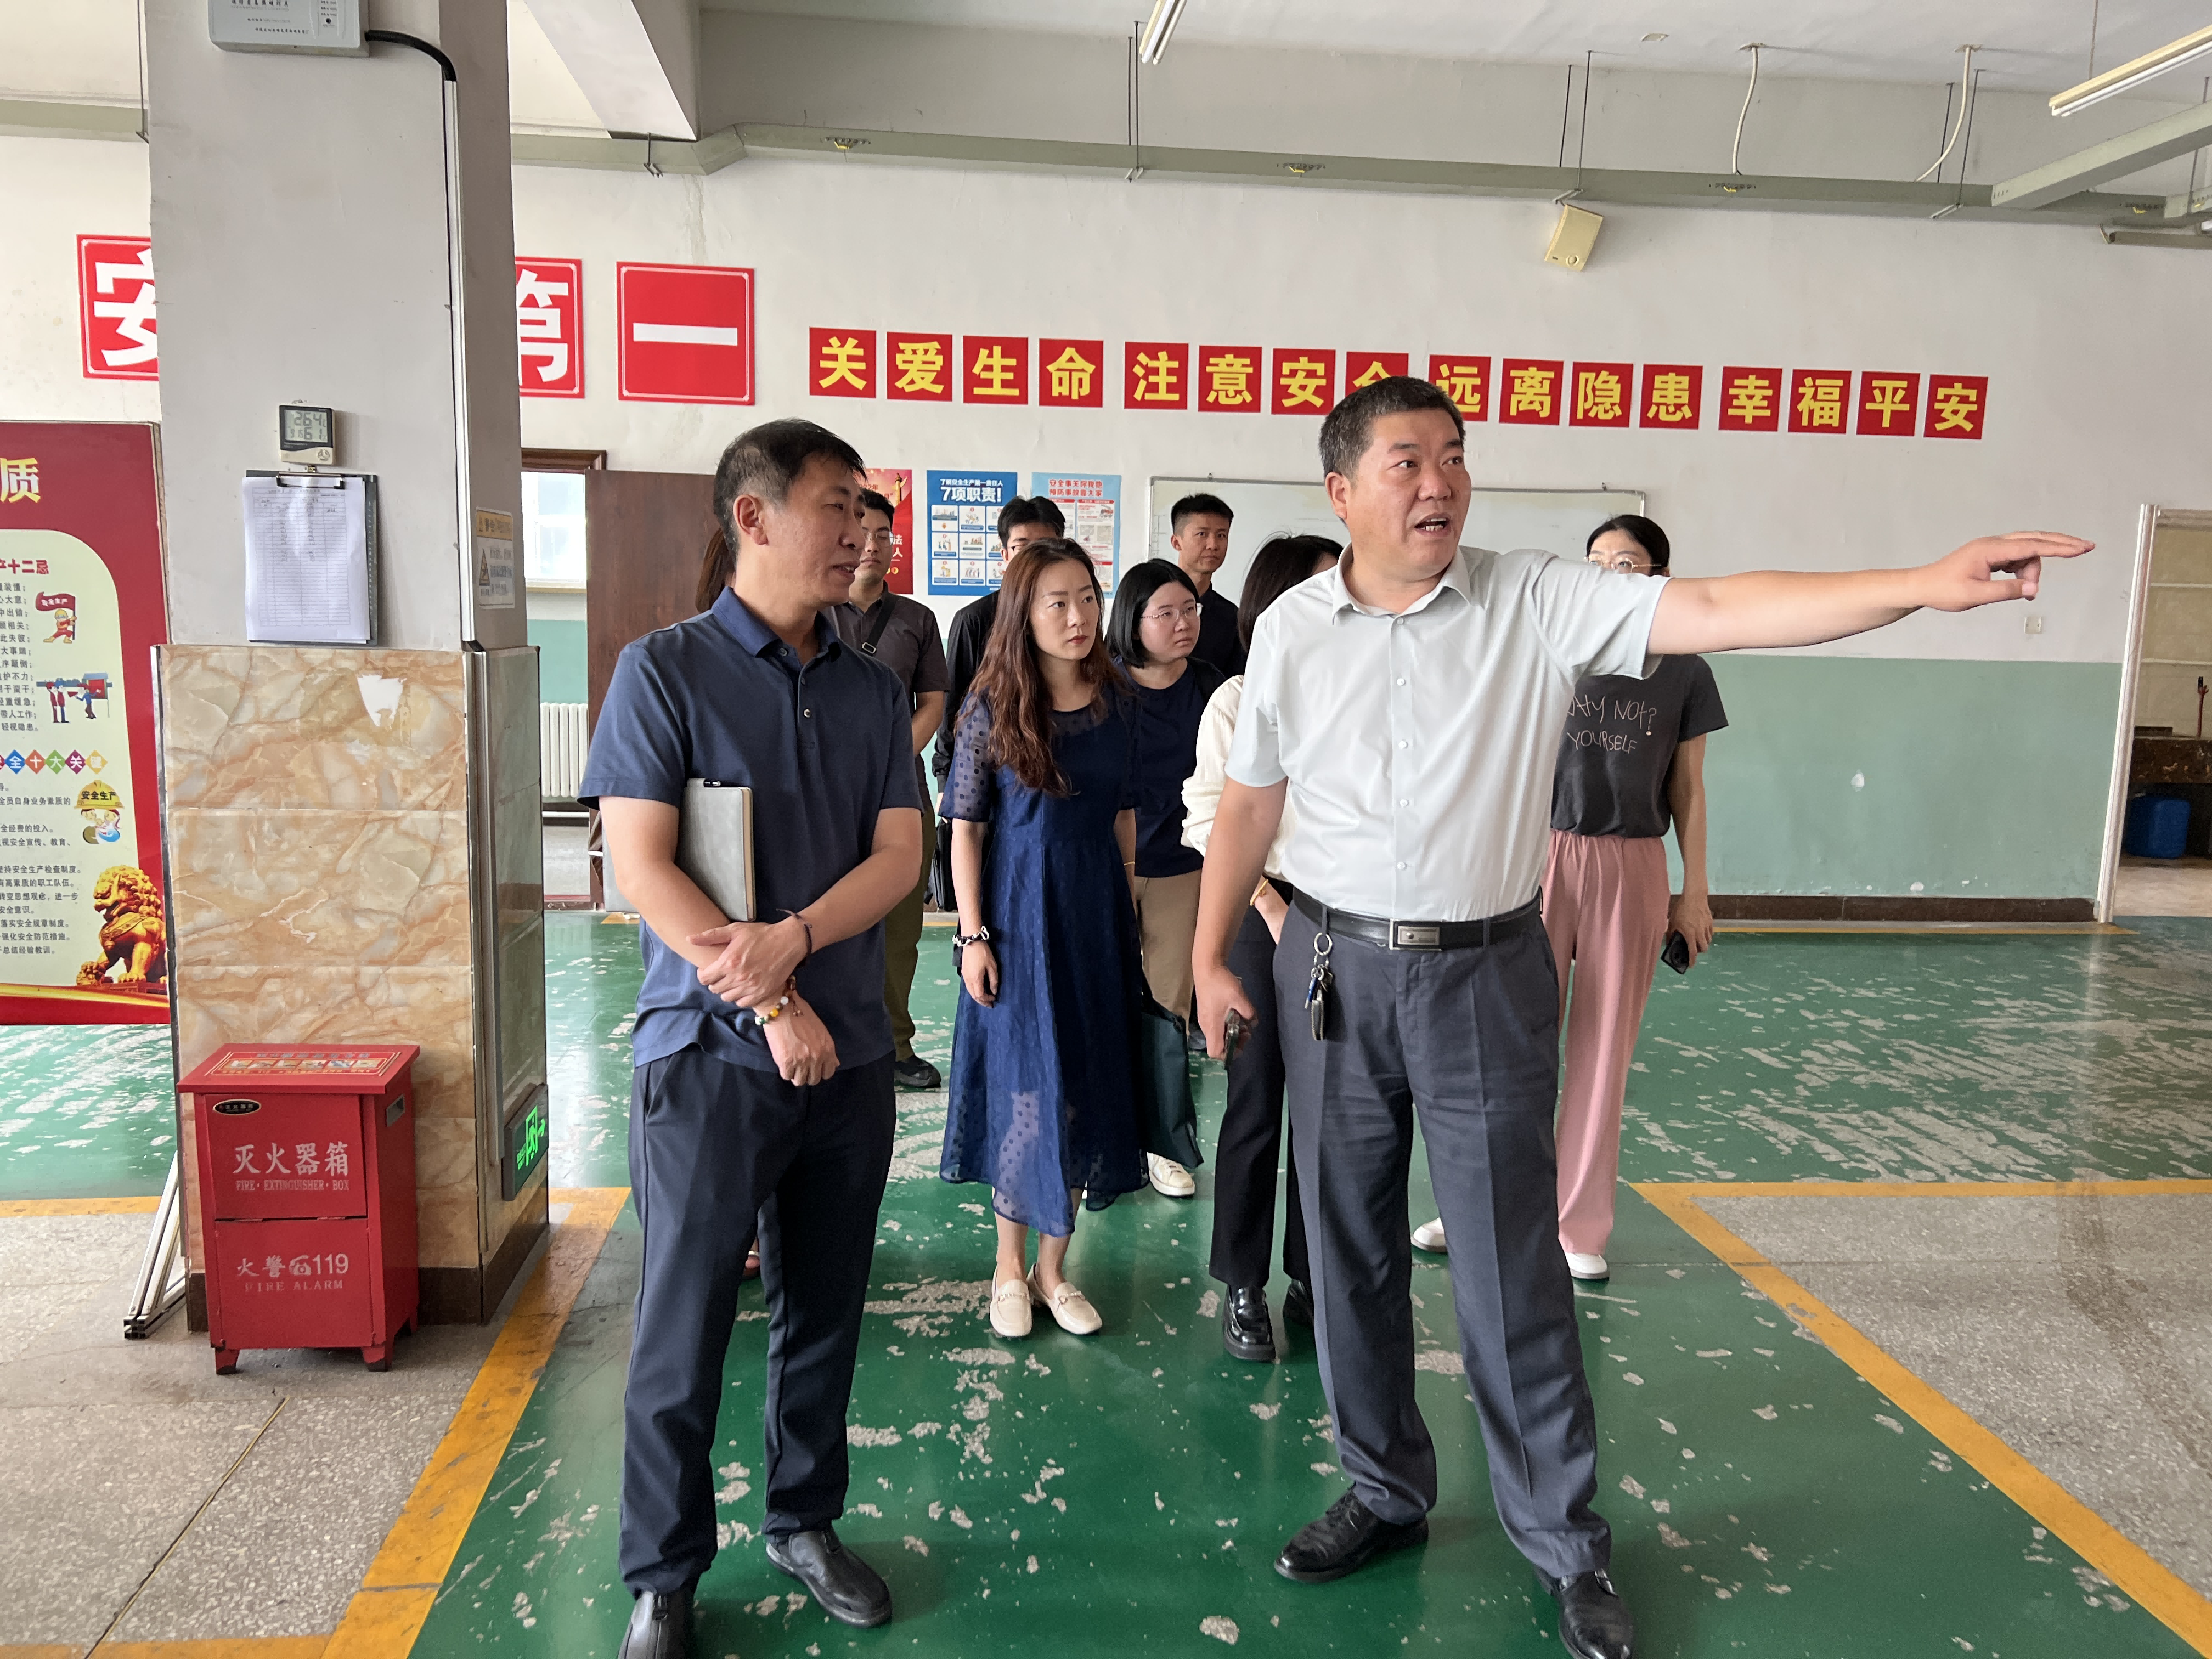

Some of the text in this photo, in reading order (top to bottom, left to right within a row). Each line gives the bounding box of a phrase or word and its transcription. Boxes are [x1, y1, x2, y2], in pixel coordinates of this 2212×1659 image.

[819, 336, 1096, 401] 关爱生命
[1436, 364, 1691, 421] 远离隐患
[1727, 374, 1978, 432] 幸福平安
[0, 457, 41, 503] 质
[1049, 479, 1102, 488] 安全事关你我他
[940, 486, 1002, 503] 7项职责!
[1049, 489, 1102, 497] 预防事故靠大家
[1566, 730, 1638, 754] YOURSELF
[0, 755, 103, 769] 全十大关
[81, 791, 117, 800] 安全生产
[0, 838, 71, 847] 视安全宣传、教育、
[233, 1141, 348, 1176] 灭火器箱
[236, 1180, 349, 1190] FIRE EXTINGUISHER BOX
[236, 1253, 349, 1278] 火警 119
[292, 1279, 343, 1291] ALARM
